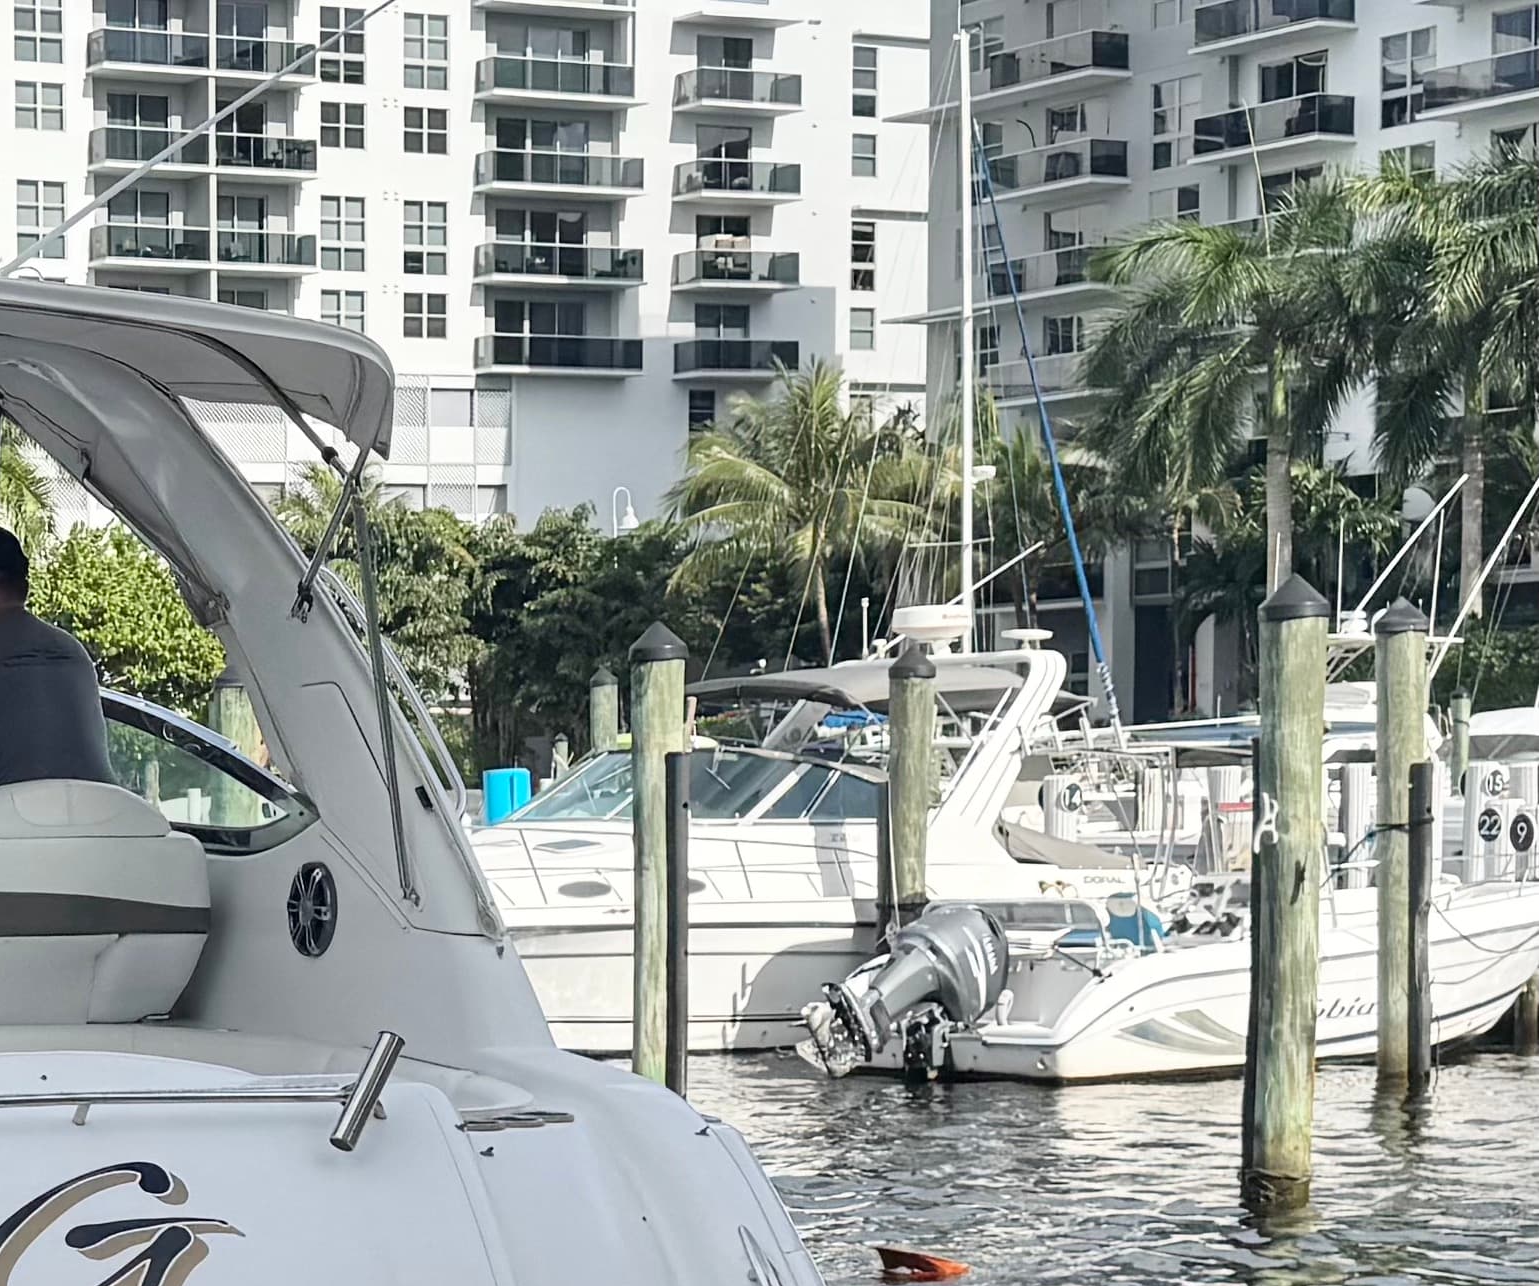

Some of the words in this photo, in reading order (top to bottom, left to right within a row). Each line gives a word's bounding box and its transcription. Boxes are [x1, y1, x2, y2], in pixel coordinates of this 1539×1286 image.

[1488, 774, 1503, 792] 15
[1065, 789, 1082, 807] 14
[1480, 815, 1501, 836] 22
[1516, 822, 1528, 844] 9
